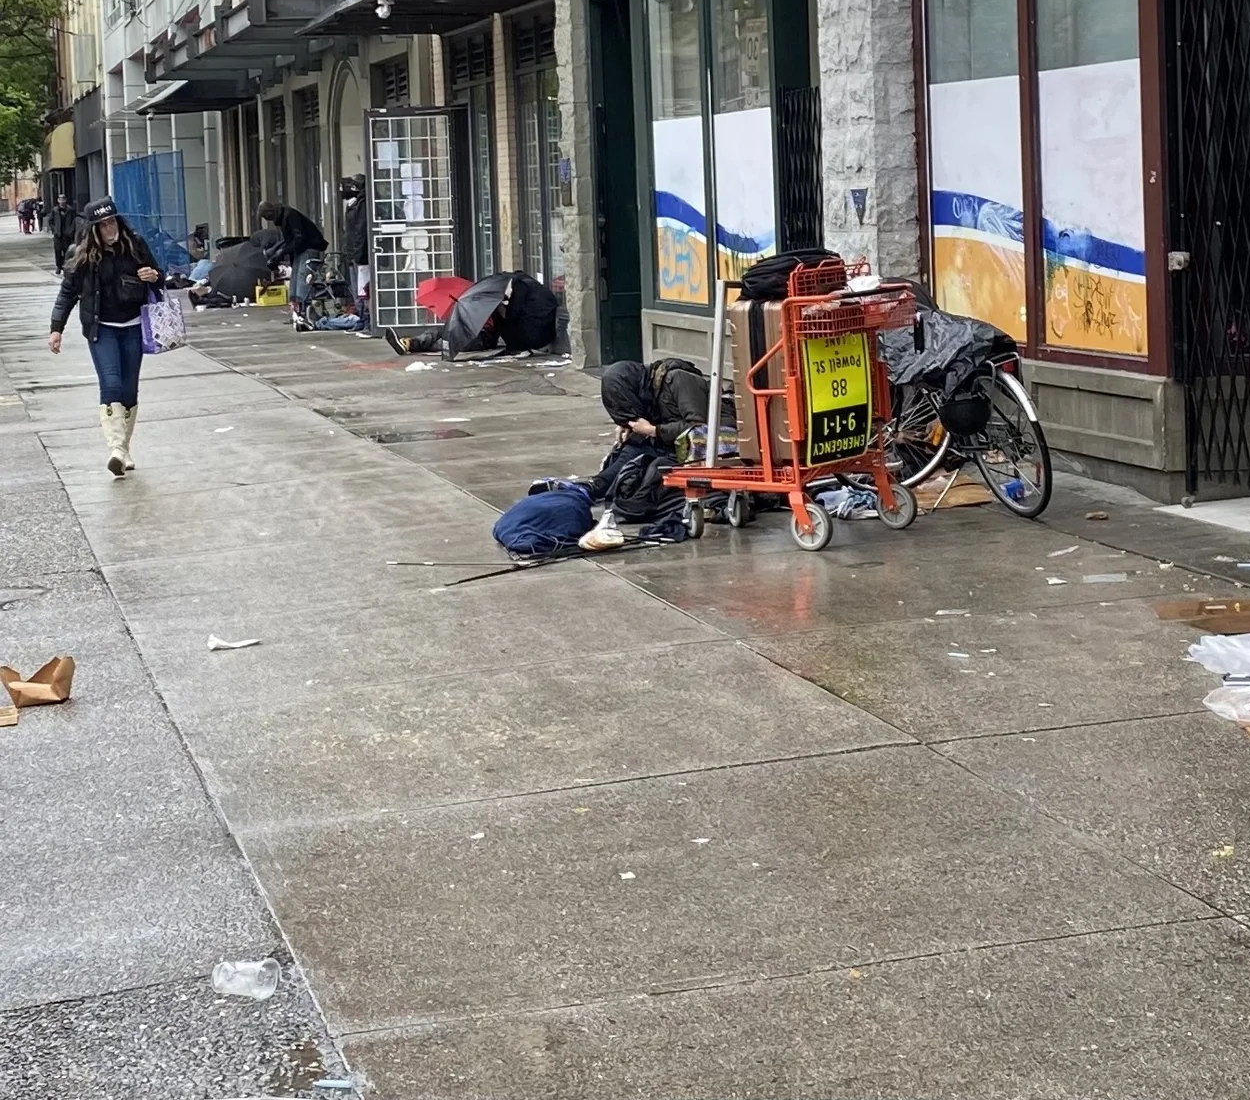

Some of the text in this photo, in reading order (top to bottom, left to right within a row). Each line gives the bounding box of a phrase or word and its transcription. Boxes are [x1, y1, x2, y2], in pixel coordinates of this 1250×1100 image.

[829, 354, 861, 372] Powell
[831, 378, 847, 398] 88
[823, 412, 856, 436] 9-1-1
[813, 434, 865, 456] EMERGENCY
